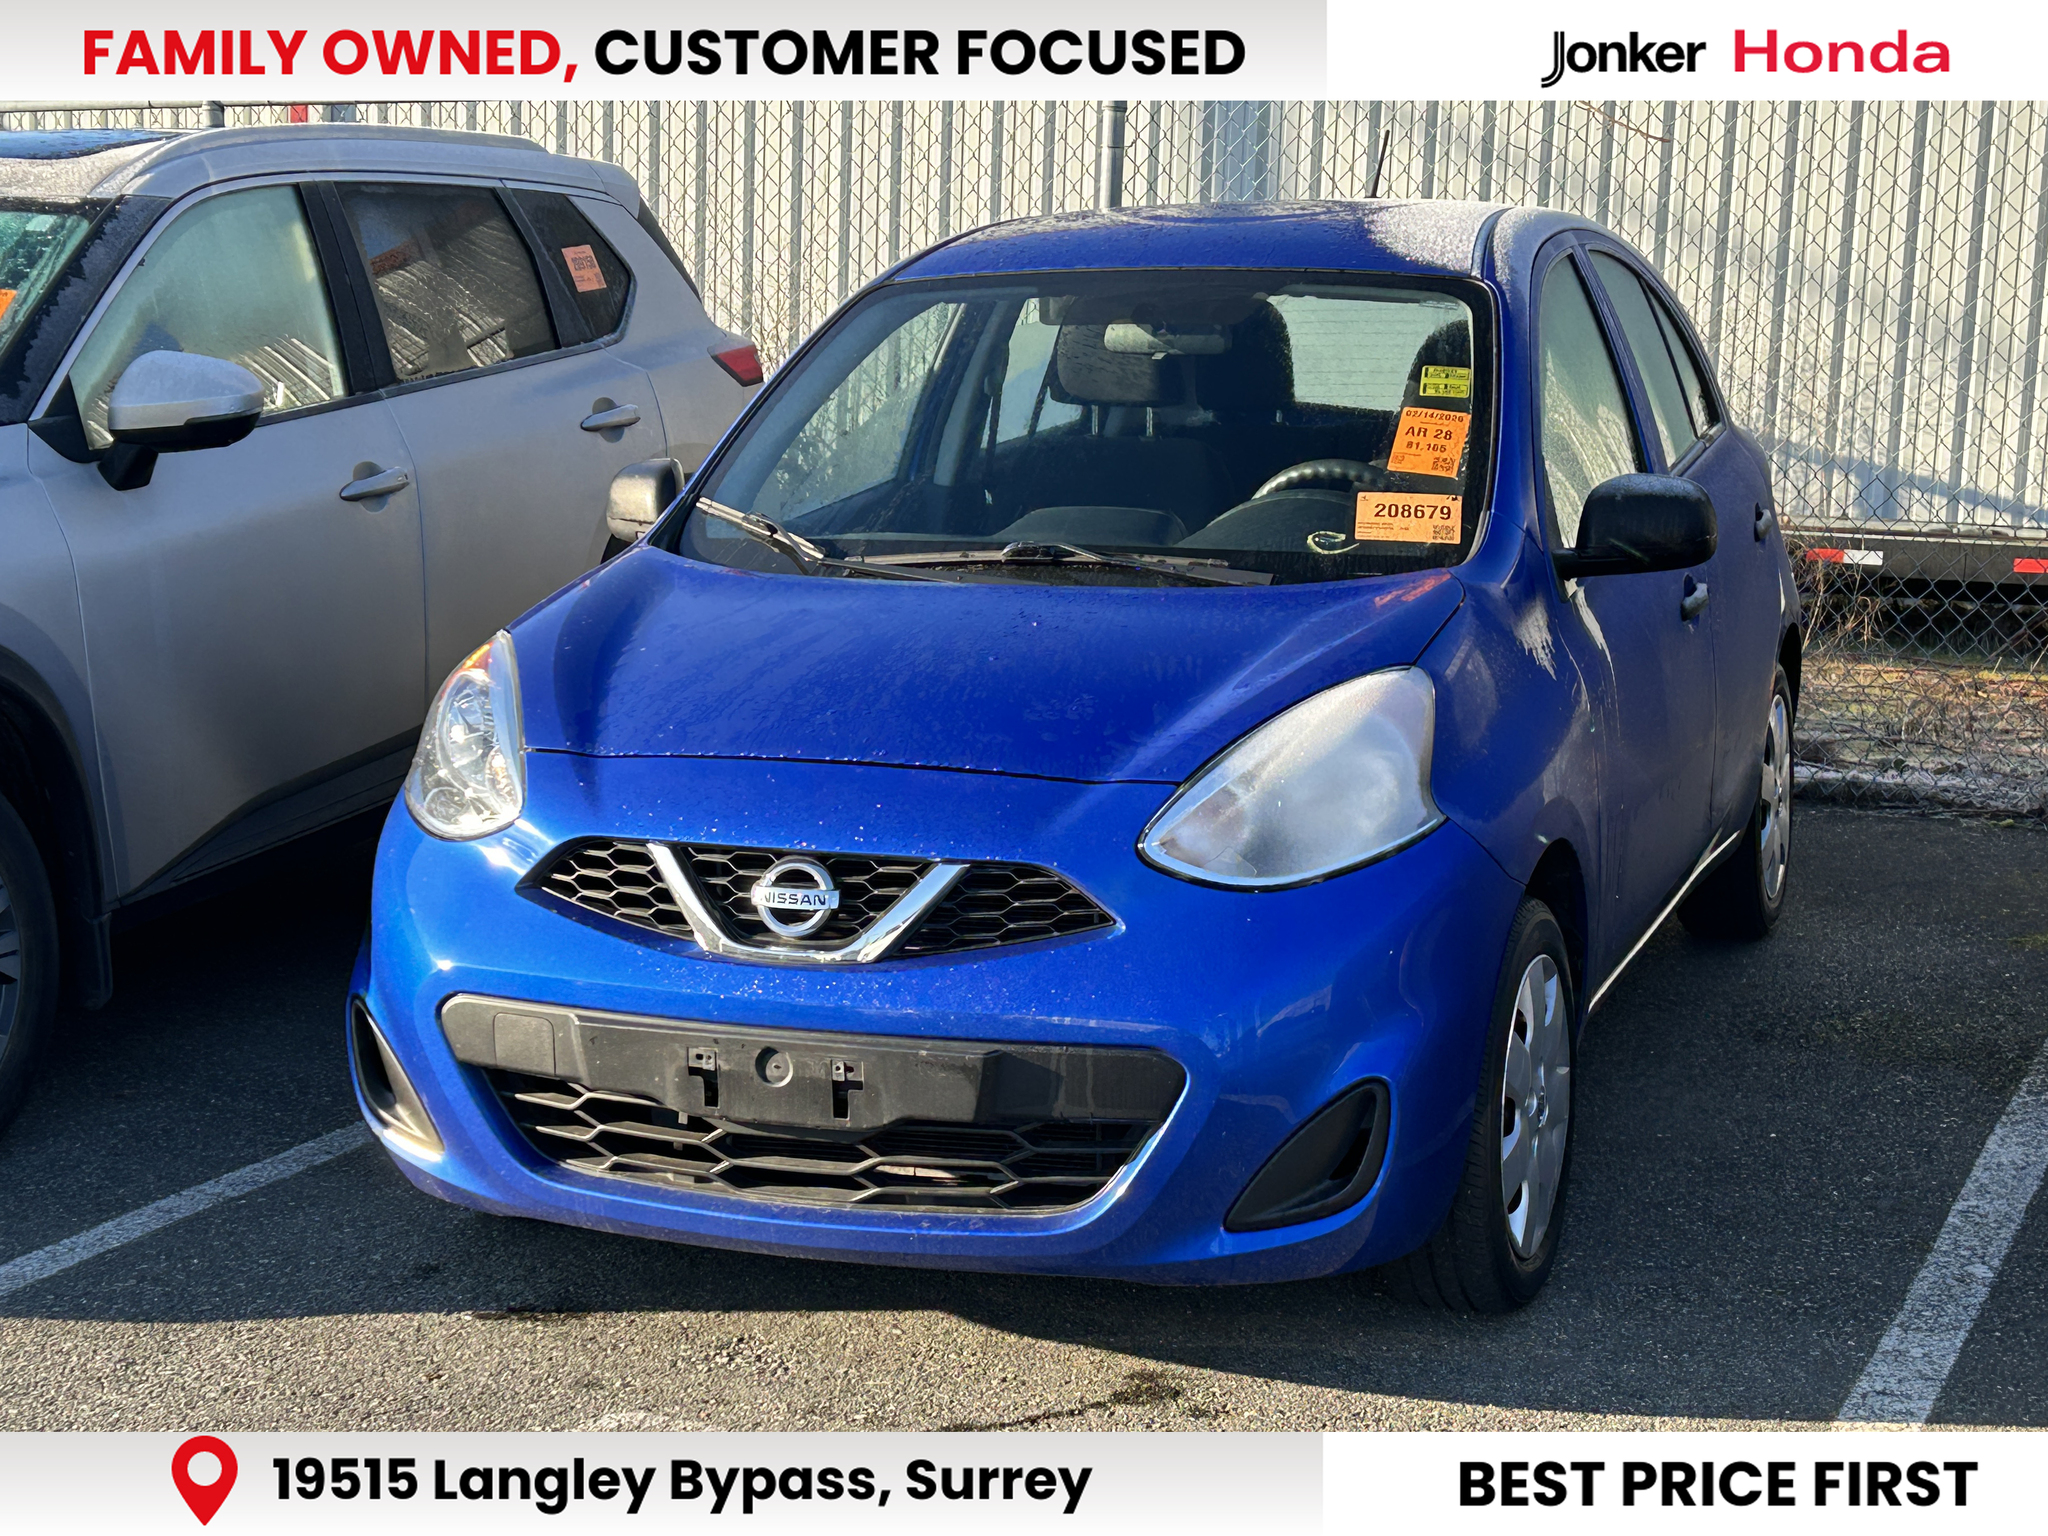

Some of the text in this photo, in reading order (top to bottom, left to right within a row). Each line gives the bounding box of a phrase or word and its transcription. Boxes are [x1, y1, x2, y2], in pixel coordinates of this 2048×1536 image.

[1405, 426, 1453, 441] AR 28
[1374, 503, 1452, 520] 208679
[761, 891, 826, 906] NISSAN
